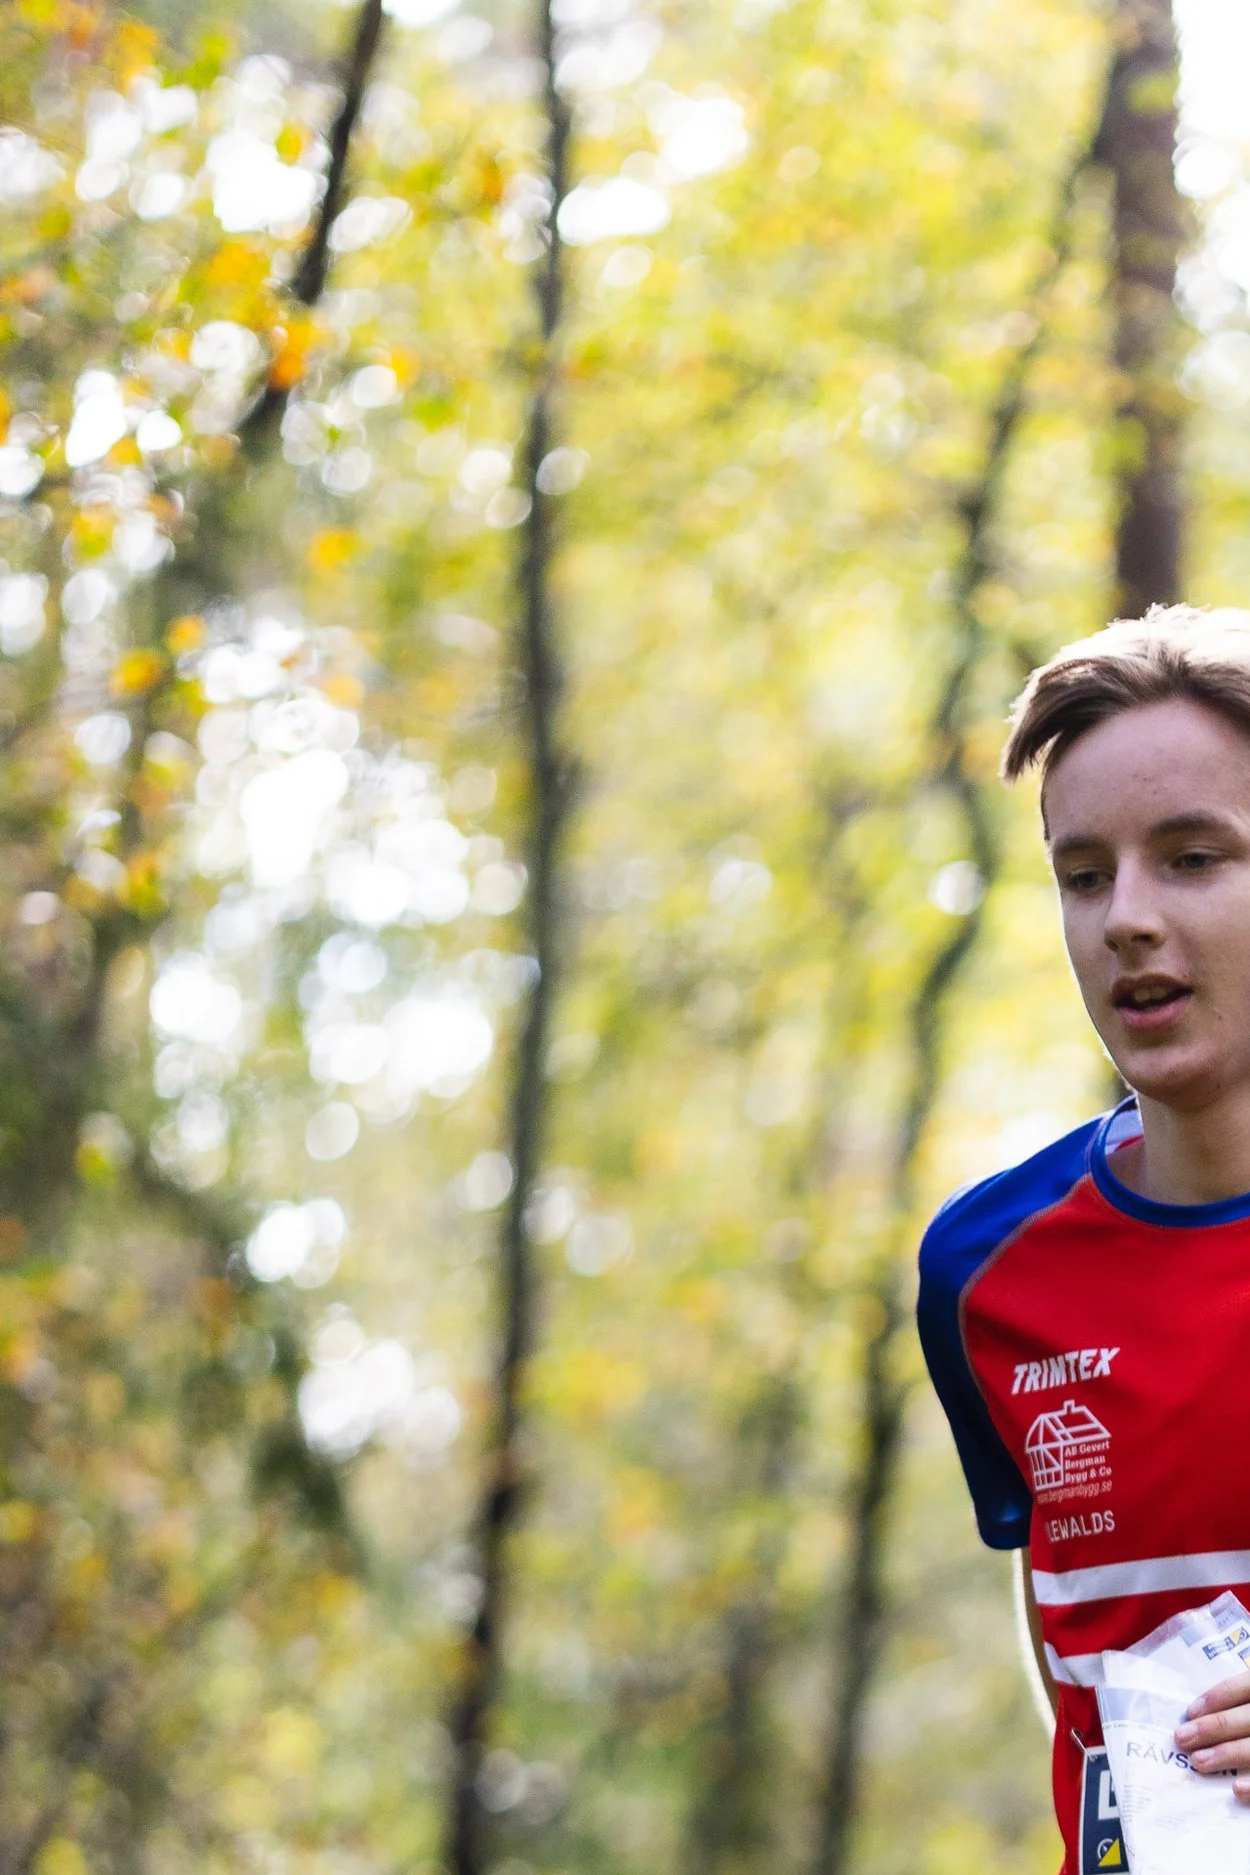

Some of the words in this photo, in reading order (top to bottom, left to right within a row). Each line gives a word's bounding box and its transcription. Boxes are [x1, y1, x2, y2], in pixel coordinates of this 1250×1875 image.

[1011, 1347, 1121, 1395] TRIMTEX
[1065, 1455, 1106, 1470] Bergman
[1099, 1466, 1112, 1477] Co
